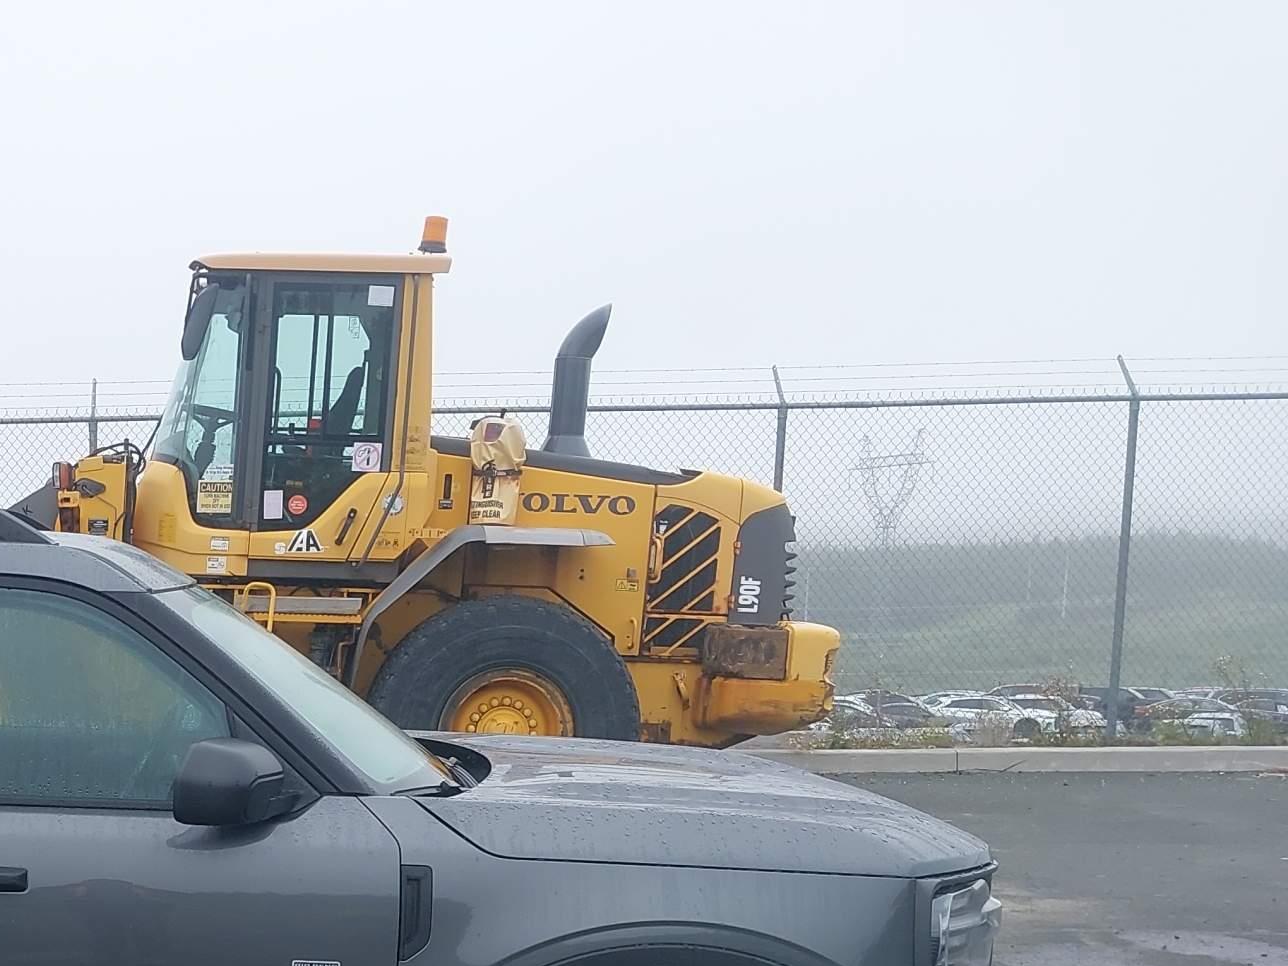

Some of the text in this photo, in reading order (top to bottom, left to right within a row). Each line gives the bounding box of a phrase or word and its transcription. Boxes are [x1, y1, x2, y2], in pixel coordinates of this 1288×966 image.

[200, 483, 232, 492] CAUTION
[520, 492, 635, 515] OLVO
[482, 510, 501, 519] CLEAR
[737, 576, 761, 613] L90F
